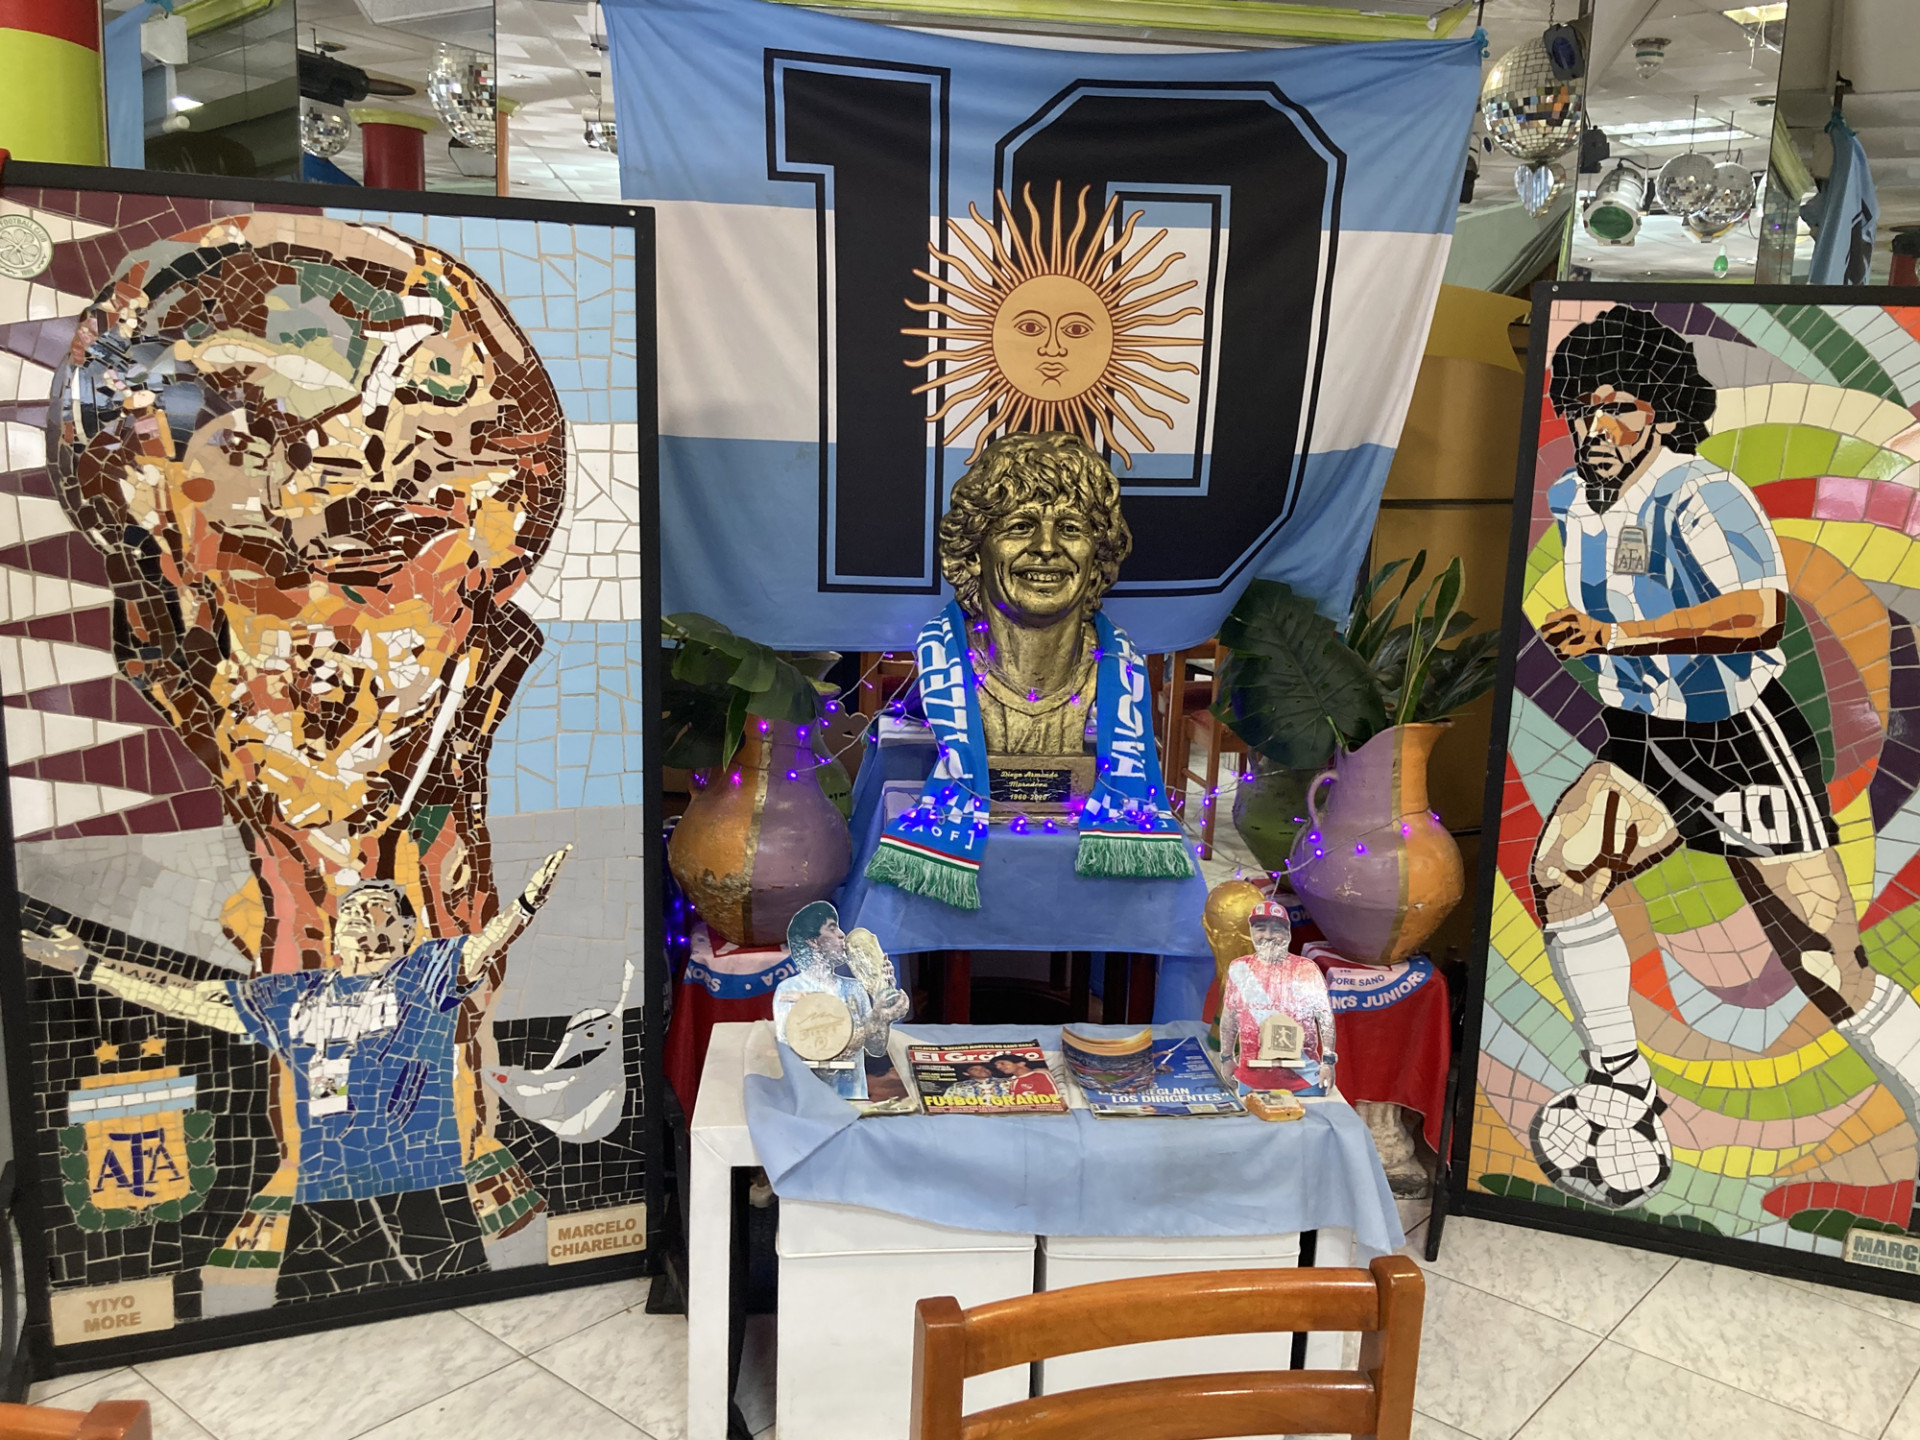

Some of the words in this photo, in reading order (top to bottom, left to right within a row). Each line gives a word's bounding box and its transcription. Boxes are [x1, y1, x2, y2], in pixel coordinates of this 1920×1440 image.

[764, 48, 1347, 596] 10
[1713, 784, 1791, 845] 10
[1362, 970, 1427, 1009] JUNIORS
[914, 1052, 940, 1062] El
[944, 1050, 1040, 1062] Gráo
[924, 1095, 989, 1107] FUTBOL
[990, 1093, 1062, 1106] GRANDE
[1111, 1095, 1139, 1104] LOS
[92, 1127, 185, 1198] AFA
[558, 1218, 637, 1241] MARCELO
[550, 1233, 644, 1258] CHIARELLO
[86, 1295, 136, 1314] YIYO
[83, 1311, 142, 1333] MORE
